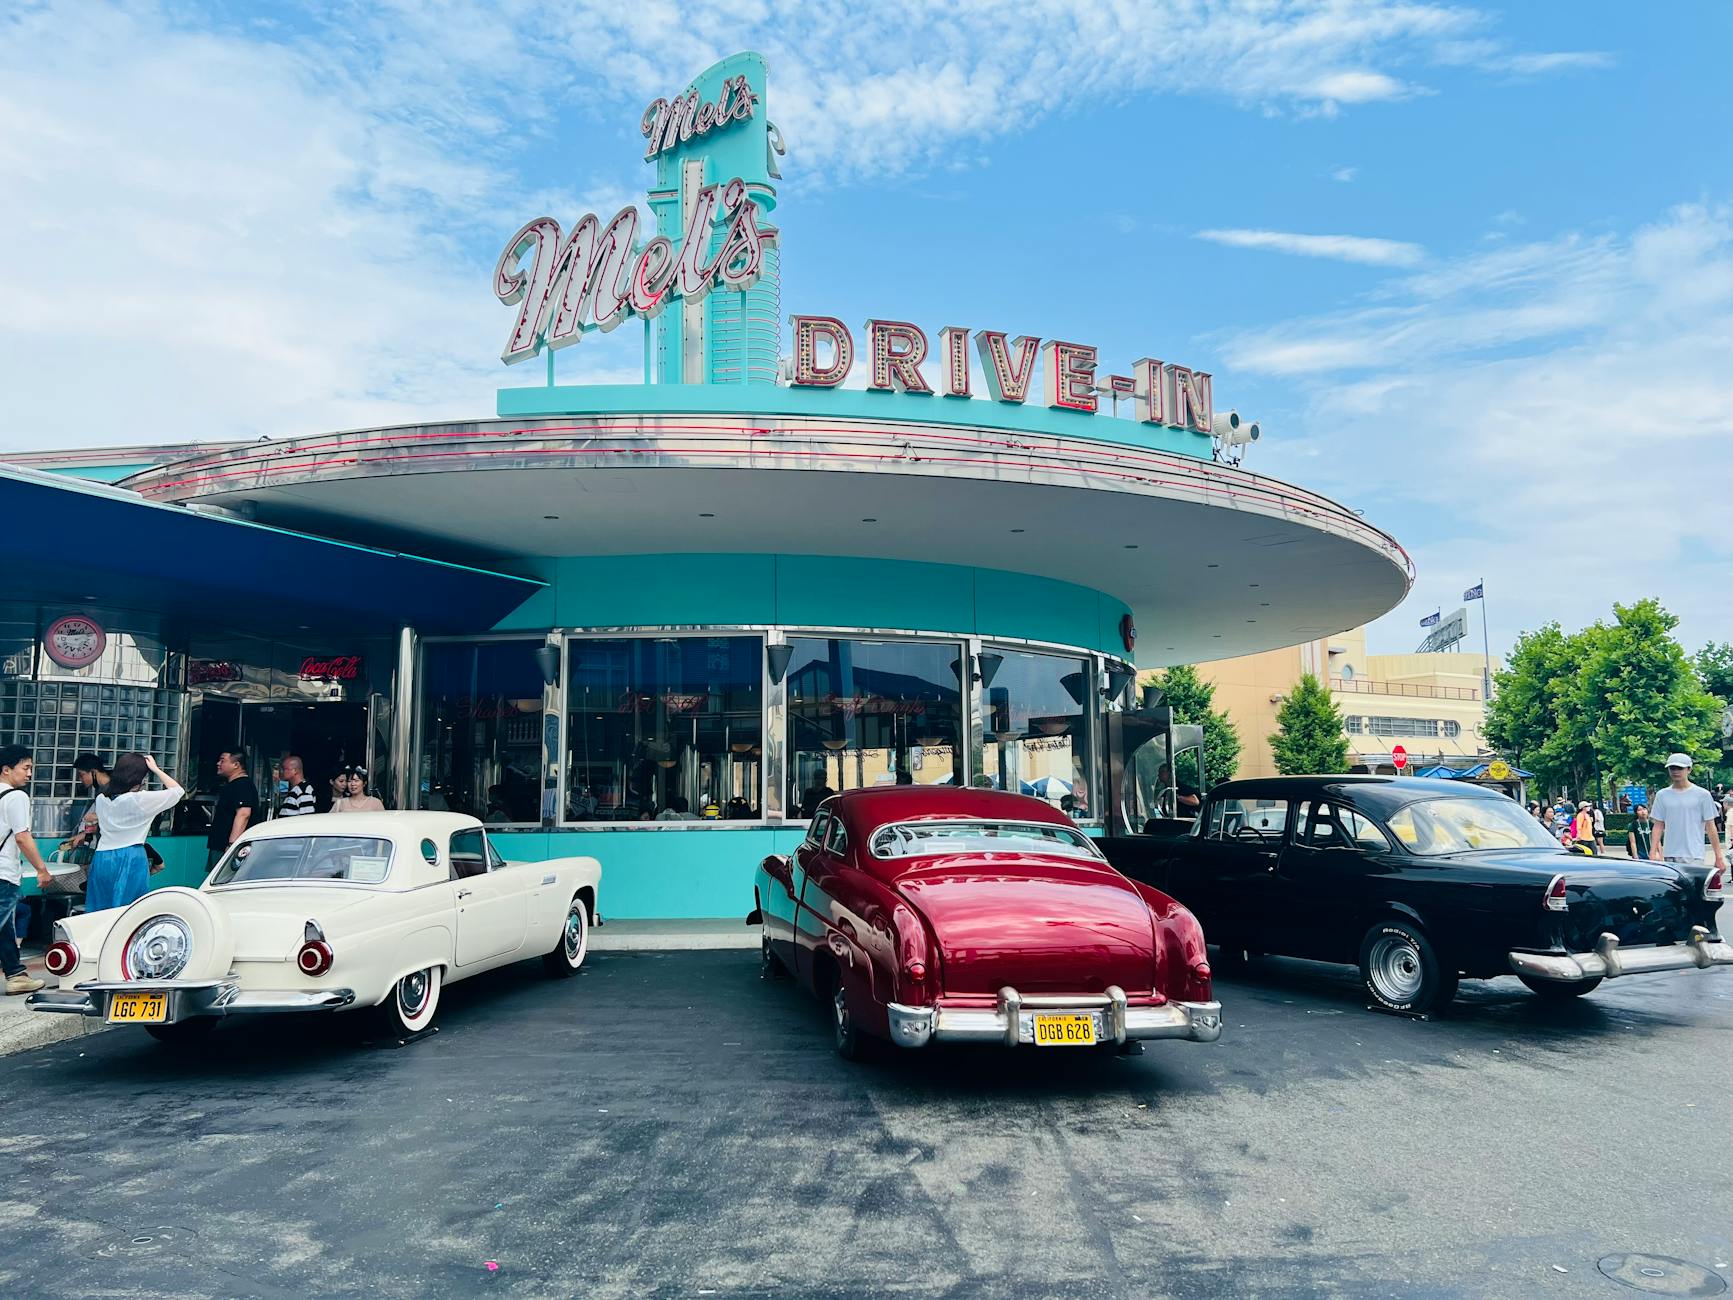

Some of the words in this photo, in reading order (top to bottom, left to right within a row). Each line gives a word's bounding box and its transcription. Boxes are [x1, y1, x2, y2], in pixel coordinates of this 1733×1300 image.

[642, 75, 759, 163] Mel's
[493, 176, 779, 366] Mel's
[789, 314, 1213, 434] DRIVE-IN
[1392, 753, 1407, 761] STOP
[114, 1001, 137, 1017] LGC
[141, 1001, 161, 1017] 731
[1040, 1023, 1063, 1040] DGB
[1067, 1023, 1090, 1040] 628
